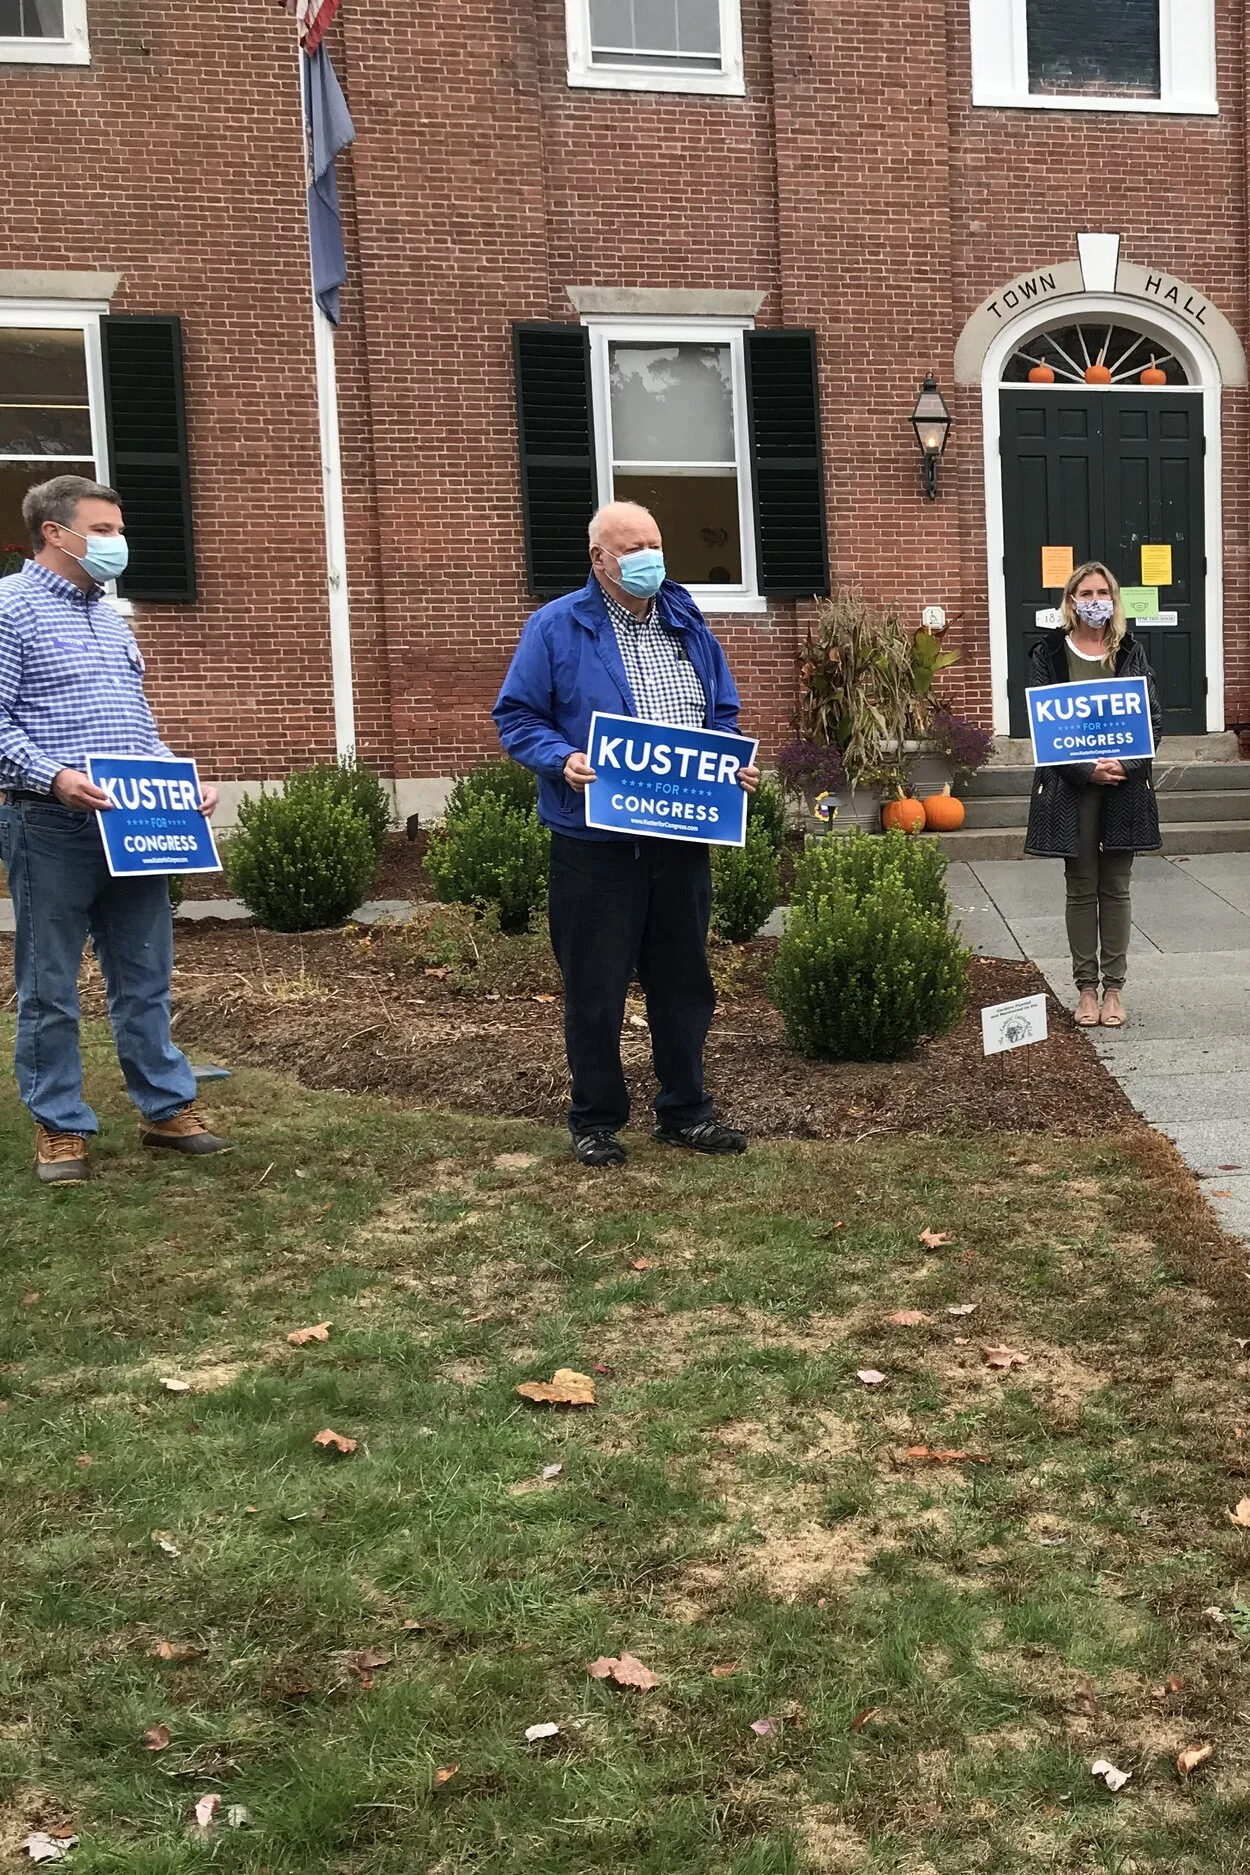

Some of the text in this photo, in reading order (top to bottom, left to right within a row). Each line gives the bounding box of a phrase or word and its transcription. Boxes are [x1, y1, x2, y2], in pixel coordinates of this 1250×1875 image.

[987, 273, 1207, 325] TOWN HALL
[1036, 692, 1142, 722] KUSTER
[1083, 722, 1101, 731] FOR
[1053, 732, 1134, 749] CONGRESS
[598, 736, 740, 785] KUSTER
[99, 778, 199, 810] KUSTER
[655, 782, 679, 795] FOR
[611, 794, 719, 822] CONGRESS
[150, 818, 168, 828] FOR
[631, 818, 699, 831] www.KusterforCongress.com
[124, 836, 198, 852] CONGRESS
